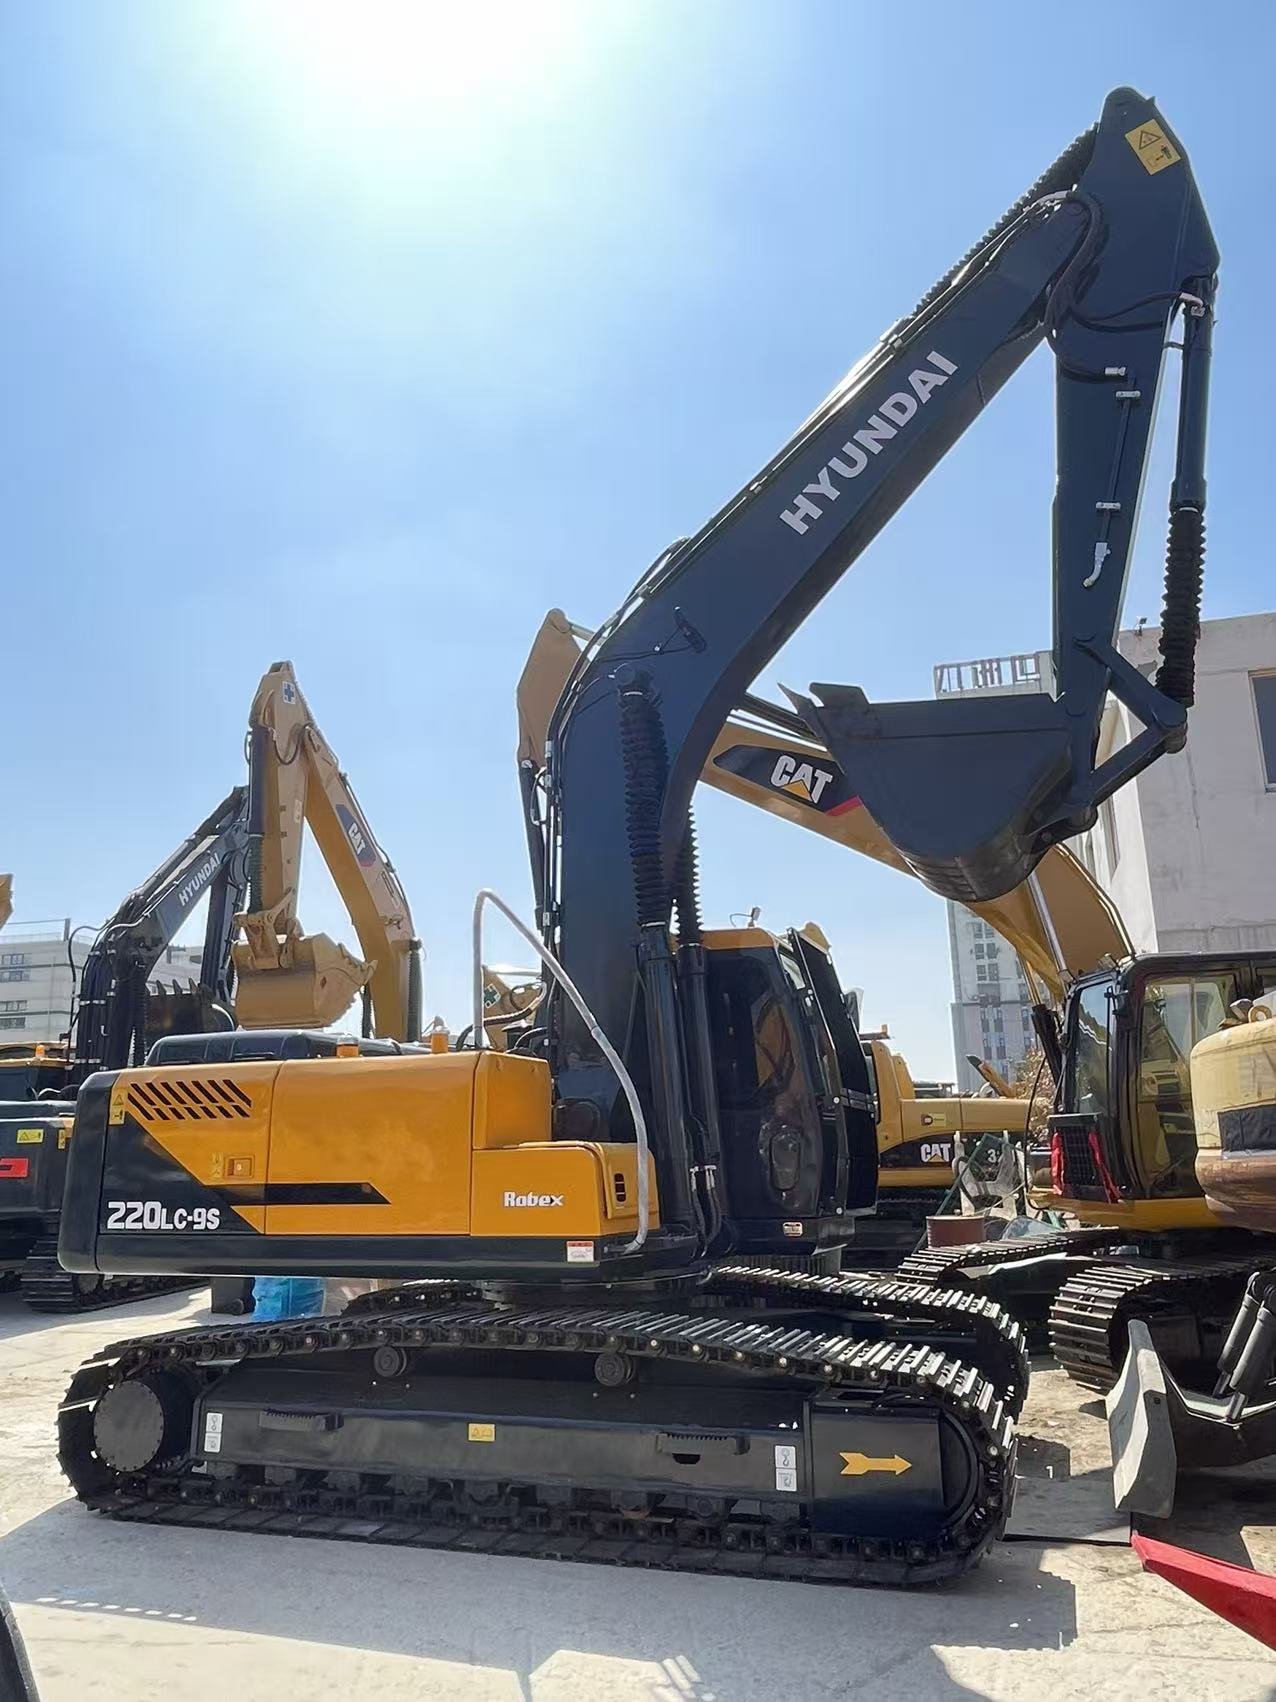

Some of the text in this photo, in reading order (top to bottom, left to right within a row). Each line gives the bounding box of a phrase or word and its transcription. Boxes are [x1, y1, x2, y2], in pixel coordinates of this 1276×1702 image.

[780, 350, 958, 535] HYUNDAI
[771, 755, 833, 803] CAT
[348, 823, 366, 855] CAT
[179, 852, 220, 906] HYUNDAI
[920, 1143, 951, 1162] CAT
[107, 1201, 220, 1230] 220LC-9S
